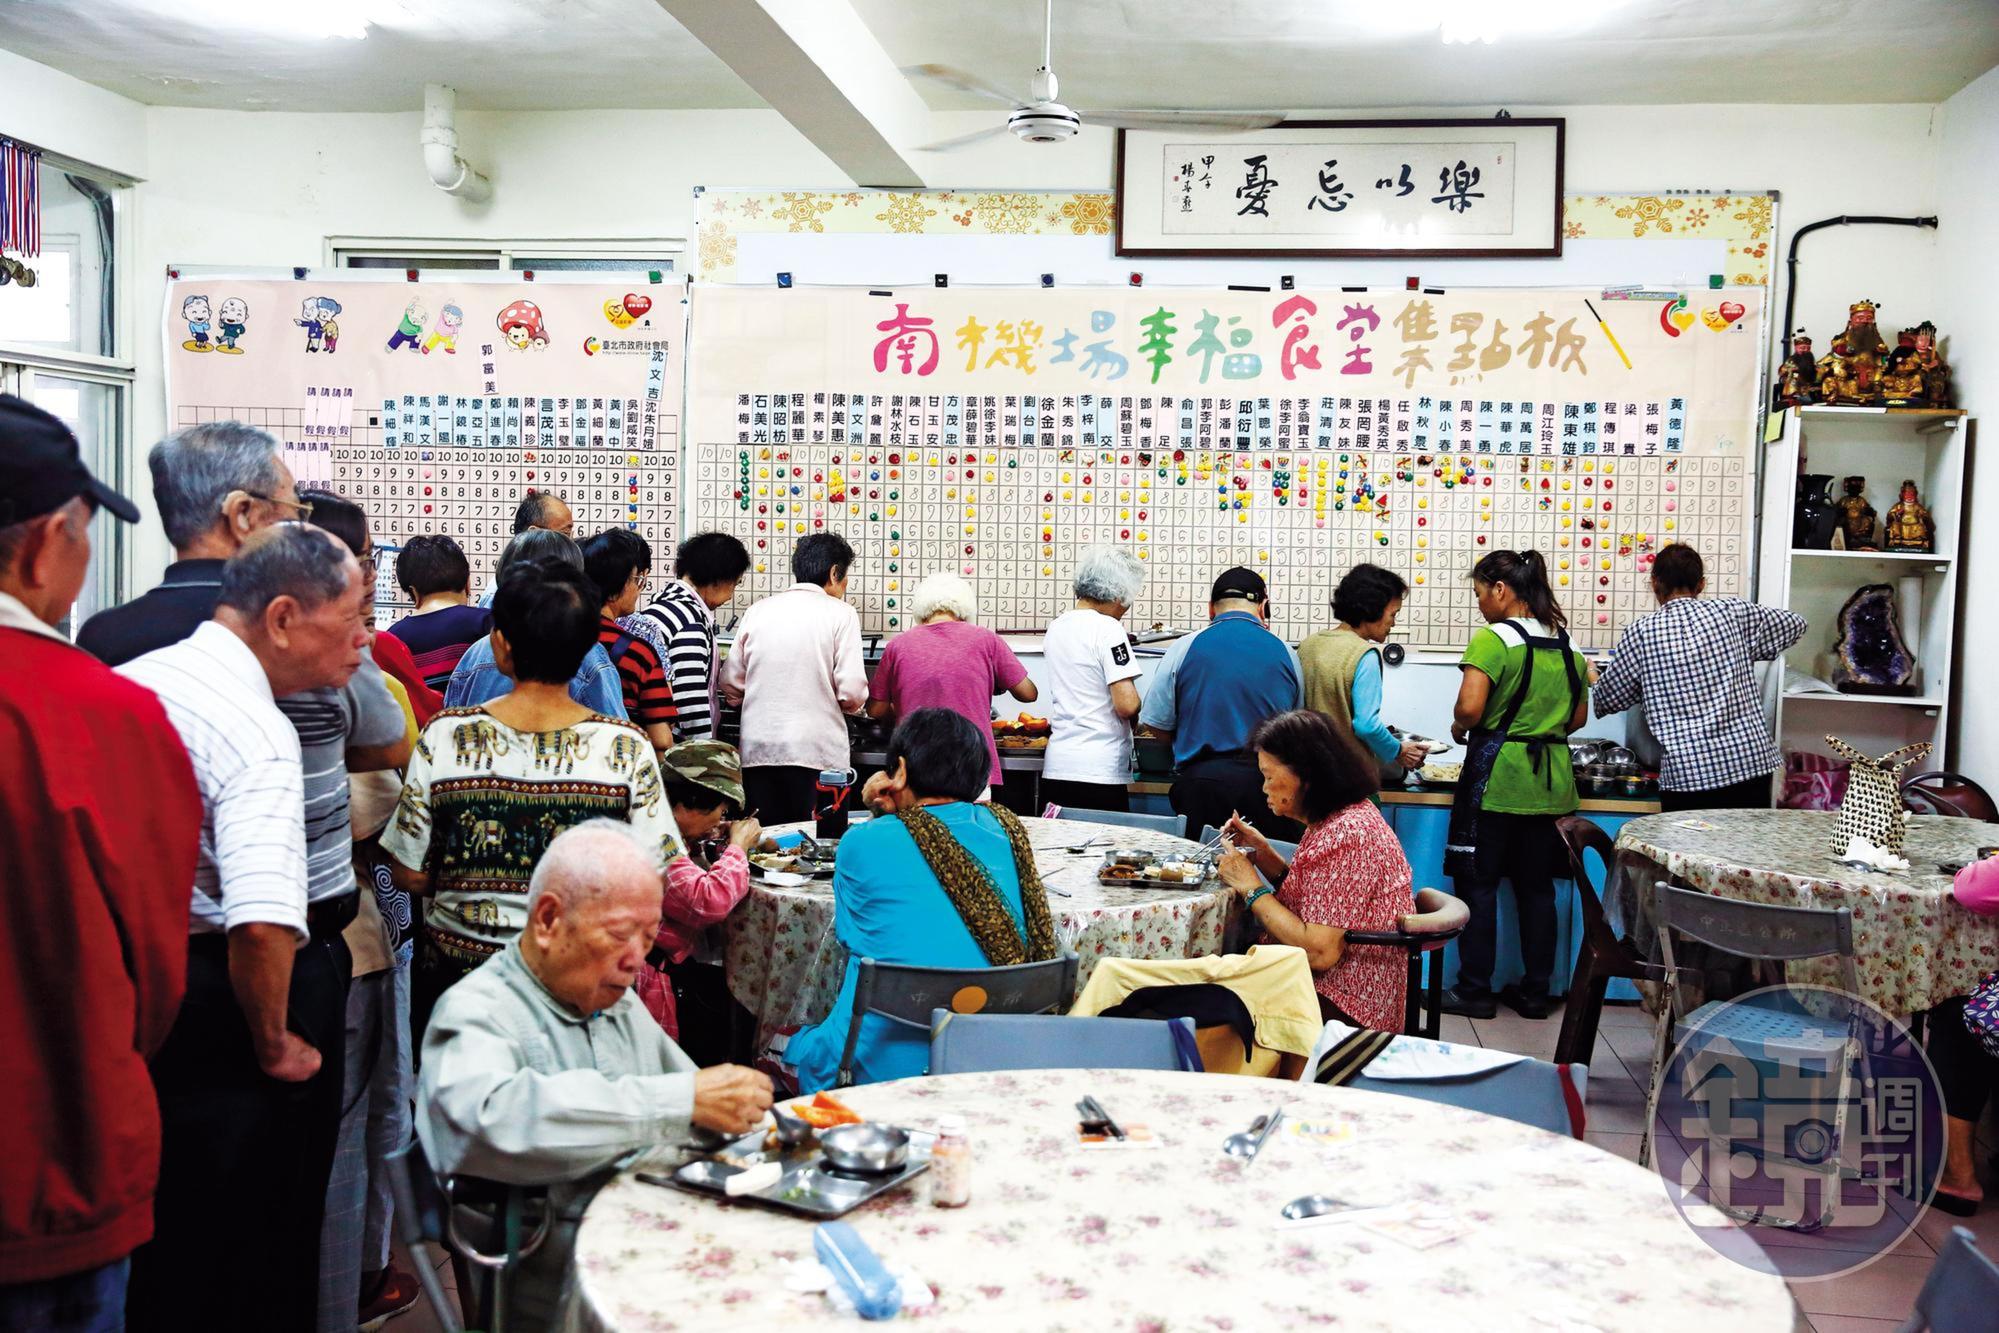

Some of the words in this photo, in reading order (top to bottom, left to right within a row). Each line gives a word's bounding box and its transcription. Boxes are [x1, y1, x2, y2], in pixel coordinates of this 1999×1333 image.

[1236, 154, 1485, 218] 樂以忘憂
[602, 340, 669, 351] 臺北市政府社會局
[872, 294, 1588, 389] 南機場幸福食堂集點板
[481, 344, 496, 393] 郭富美
[648, 350, 664, 399] 沈文吉
[419, 396, 431, 444] 馬漢文
[754, 395, 768, 443] 石美光
[791, 393, 805, 441] 程麗華
[831, 393, 845, 442] 陳美惠
[850, 395, 864, 443] 陳文洲
[890, 395, 903, 444] 謝林水枝
[908, 396, 921, 445] 陳石玉
[927, 396, 939, 445] 甘玉安
[945, 395, 958, 444] 方茂忠
[1041, 397, 1055, 447] 徐金蘭
[1158, 397, 1173, 447] 陳足
[1439, 400, 1452, 451] 陳小春
[1460, 400, 1473, 451] 周秀美
[1562, 404, 1579, 456] 陳東雄
[1645, 403, 1659, 454] 張梅子
[336, 449, 349, 459] 10
[353, 449, 366, 460] 10
[370, 450, 384, 460] 10
[387, 450, 401, 461] 10
[404, 450, 418, 461] 10
[438, 451, 452, 462] 10
[455, 452, 469, 462] 10
[472, 452, 486, 462] 10
[489, 452, 503, 463] 10
[506, 453, 520, 463] 10
[541, 453, 554, 464] 10
[558, 454, 571, 464] 10
[575, 454, 589, 465] 10
[592, 454, 606, 465] 10
[609, 455, 623, 465] 10
[644, 456, 658, 466] 10
[661, 456, 675, 466] 10
[339, 466, 346, 477] 9
[355, 467, 363, 478] 9
[373, 467, 380, 478] 9
[390, 467, 397, 479] 9
[407, 468, 414, 479] 9
[441, 469, 448, 480] 9
[458, 469, 465, 480] 9
[475, 469, 482, 481] 9
[492, 470, 499, 481] 9
[509, 470, 516, 481] 9
[543, 471, 551, 482] 9
[560, 471, 568, 482] 9
[578, 472, 585, 483] 9
[595, 472, 602, 483] 9
[612, 472, 620, 484] 9
[647, 473, 654, 484] 9
[664, 473, 672, 485] 9
[339, 484, 346, 495] 8
[356, 484, 363, 495] 8
[373, 485, 380, 495] 8
[390, 485, 397, 496] 8
[407, 486, 414, 496] 8
[441, 486, 448, 497] 8
[457, 487, 465, 497] 8
[475, 487, 482, 498] 8
[492, 488, 499, 498] 8
[509, 488, 516, 499] 8
[560, 489, 567, 499] 8
[577, 489, 585, 500] 8
[595, 490, 602, 500] 8
[612, 490, 619, 501] 8
[646, 491, 654, 502] 8
[664, 491, 671, 502] 8
[646, 509, 654, 520] 7
[664, 510, 672, 520] 7
[647, 527, 653, 538] 6
[664, 527, 671, 539] 6
[664, 545, 671, 556] 5
[663, 563, 670, 574] 4
